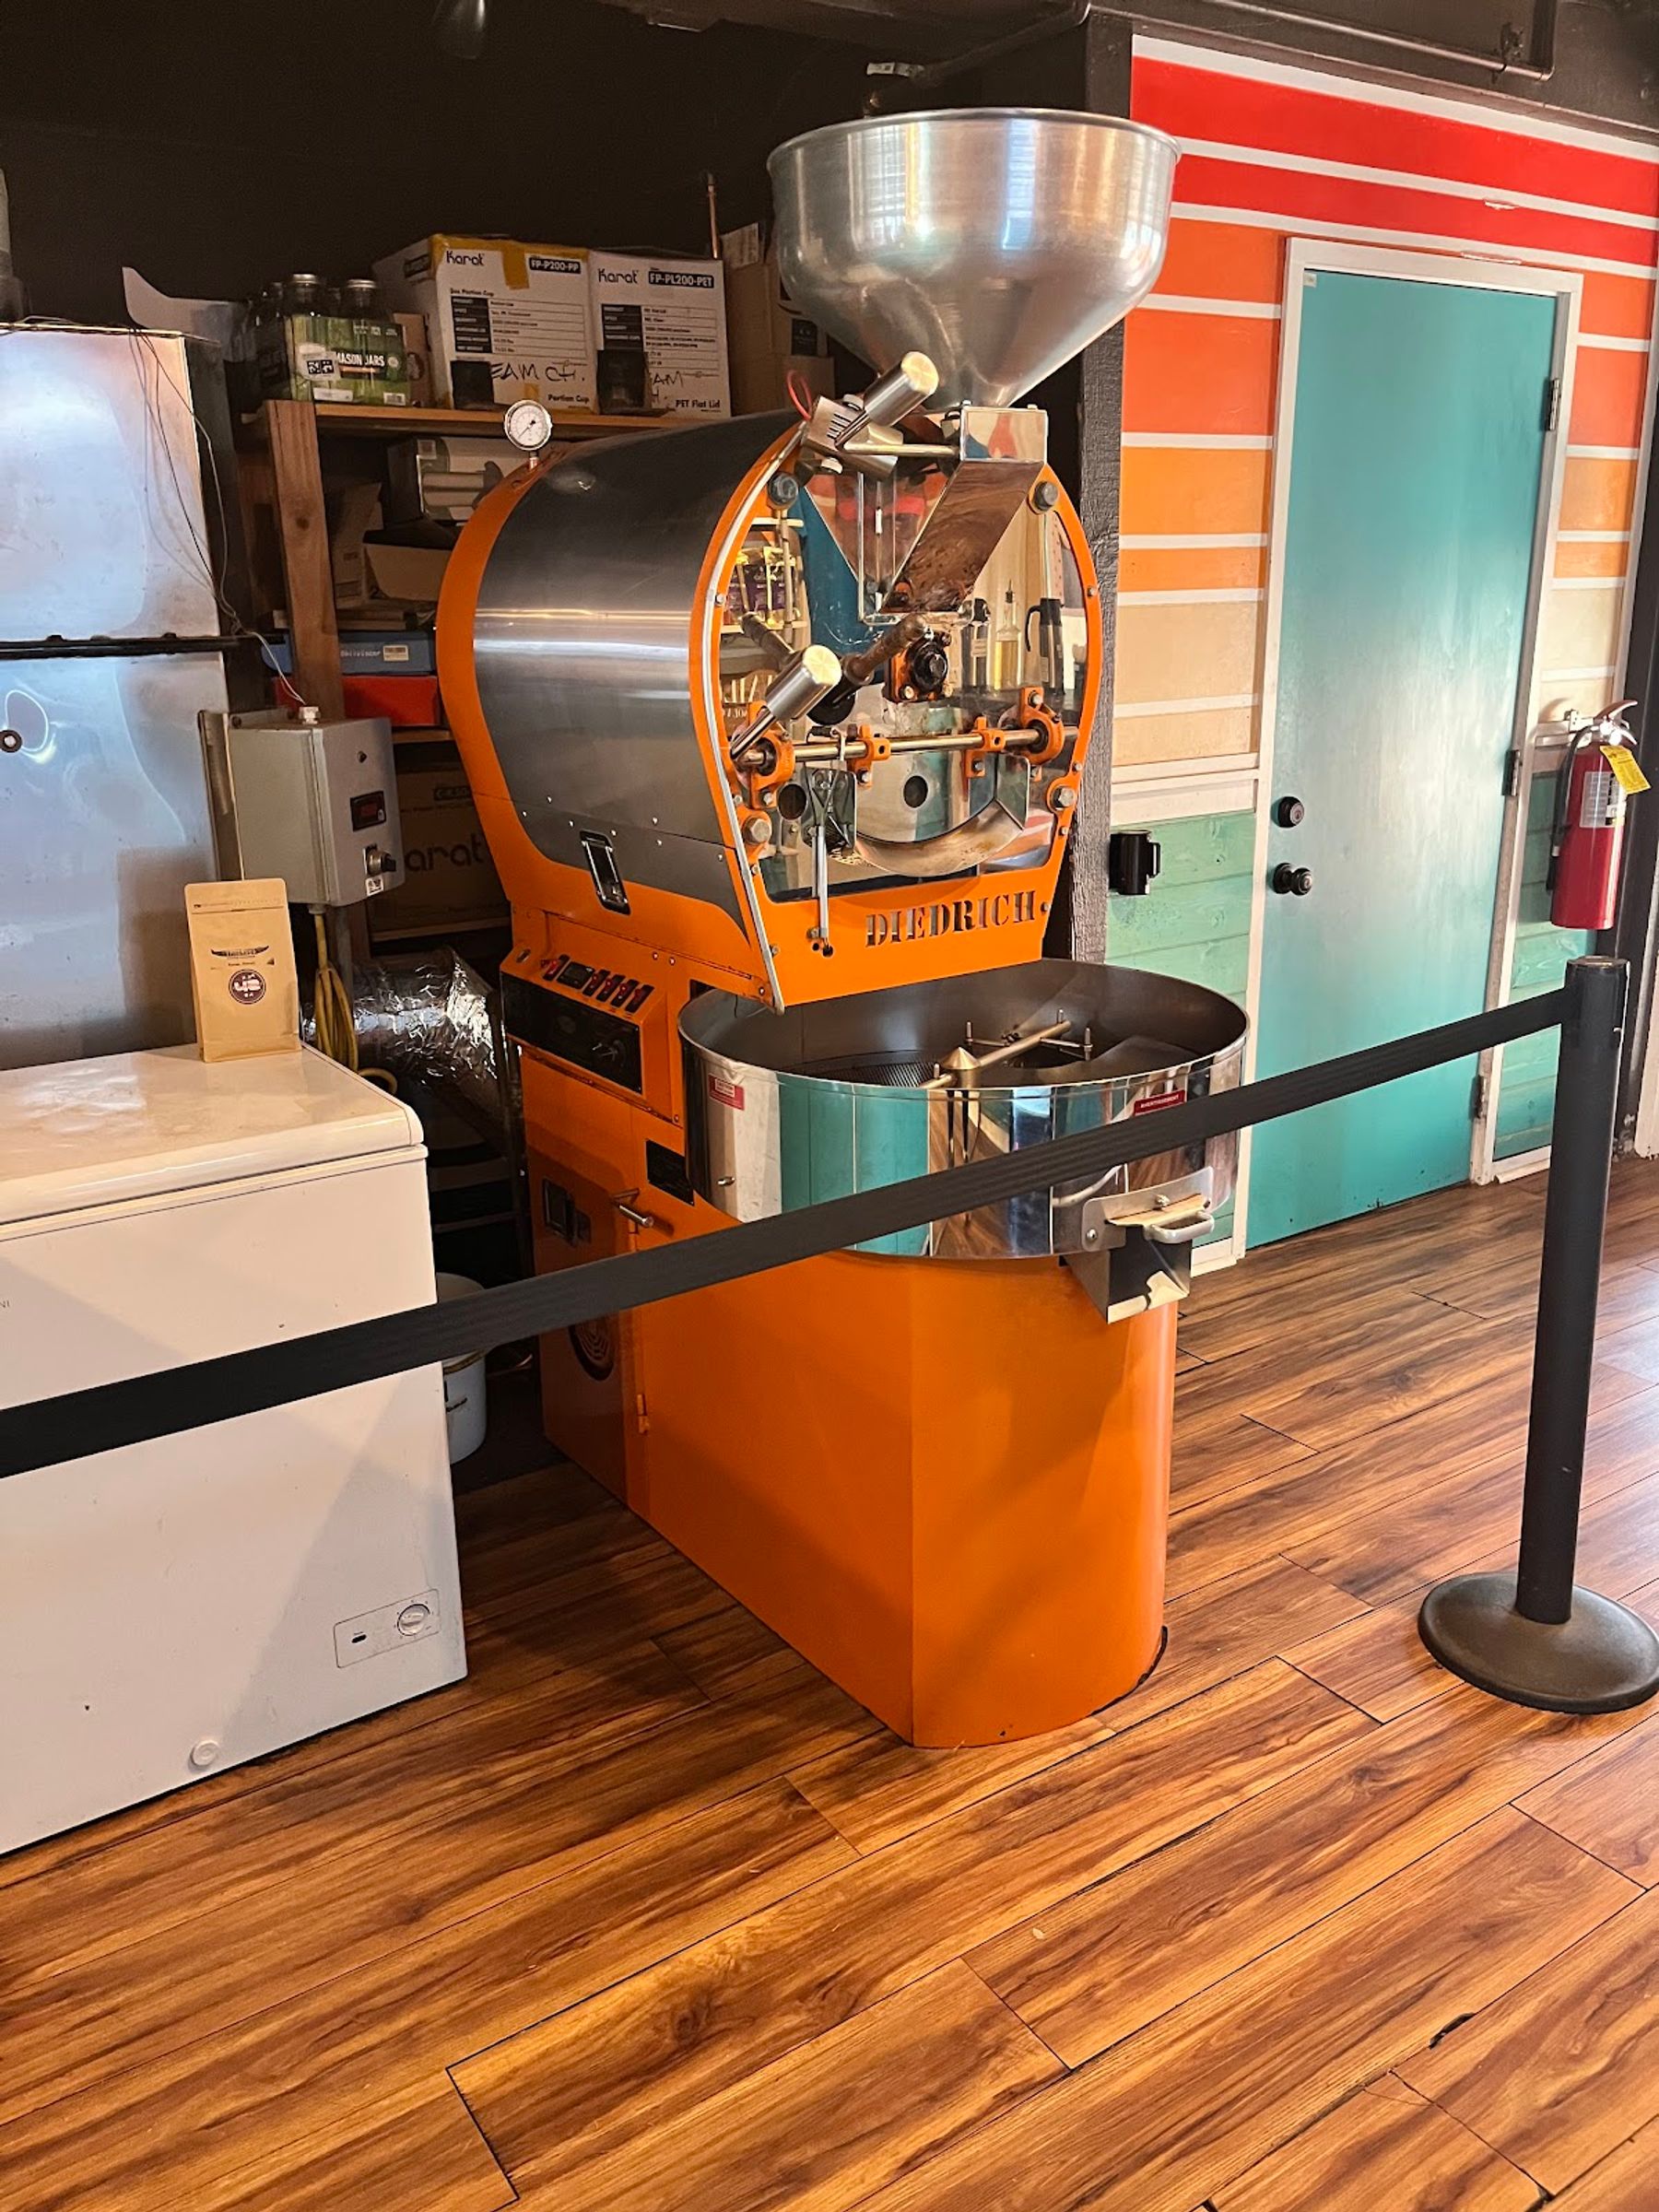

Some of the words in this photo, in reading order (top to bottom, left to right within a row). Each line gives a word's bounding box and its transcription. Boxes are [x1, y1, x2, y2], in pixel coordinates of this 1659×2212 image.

[446, 250, 485, 266] Karat
[530, 258, 581, 273] FP-P200-PP
[597, 267, 639, 284] Karat
[649, 272, 713, 288] FP-PL200-PET
[364, 354, 385, 367] JARS
[547, 394, 574, 403] Portion
[576, 394, 590, 405] Cup
[676, 399, 689, 408] PET
[691, 399, 706, 408] Flat
[709, 399, 721, 408] Lid
[405, 832, 485, 872] arat
[865, 890, 1035, 947] DIEDRICH
